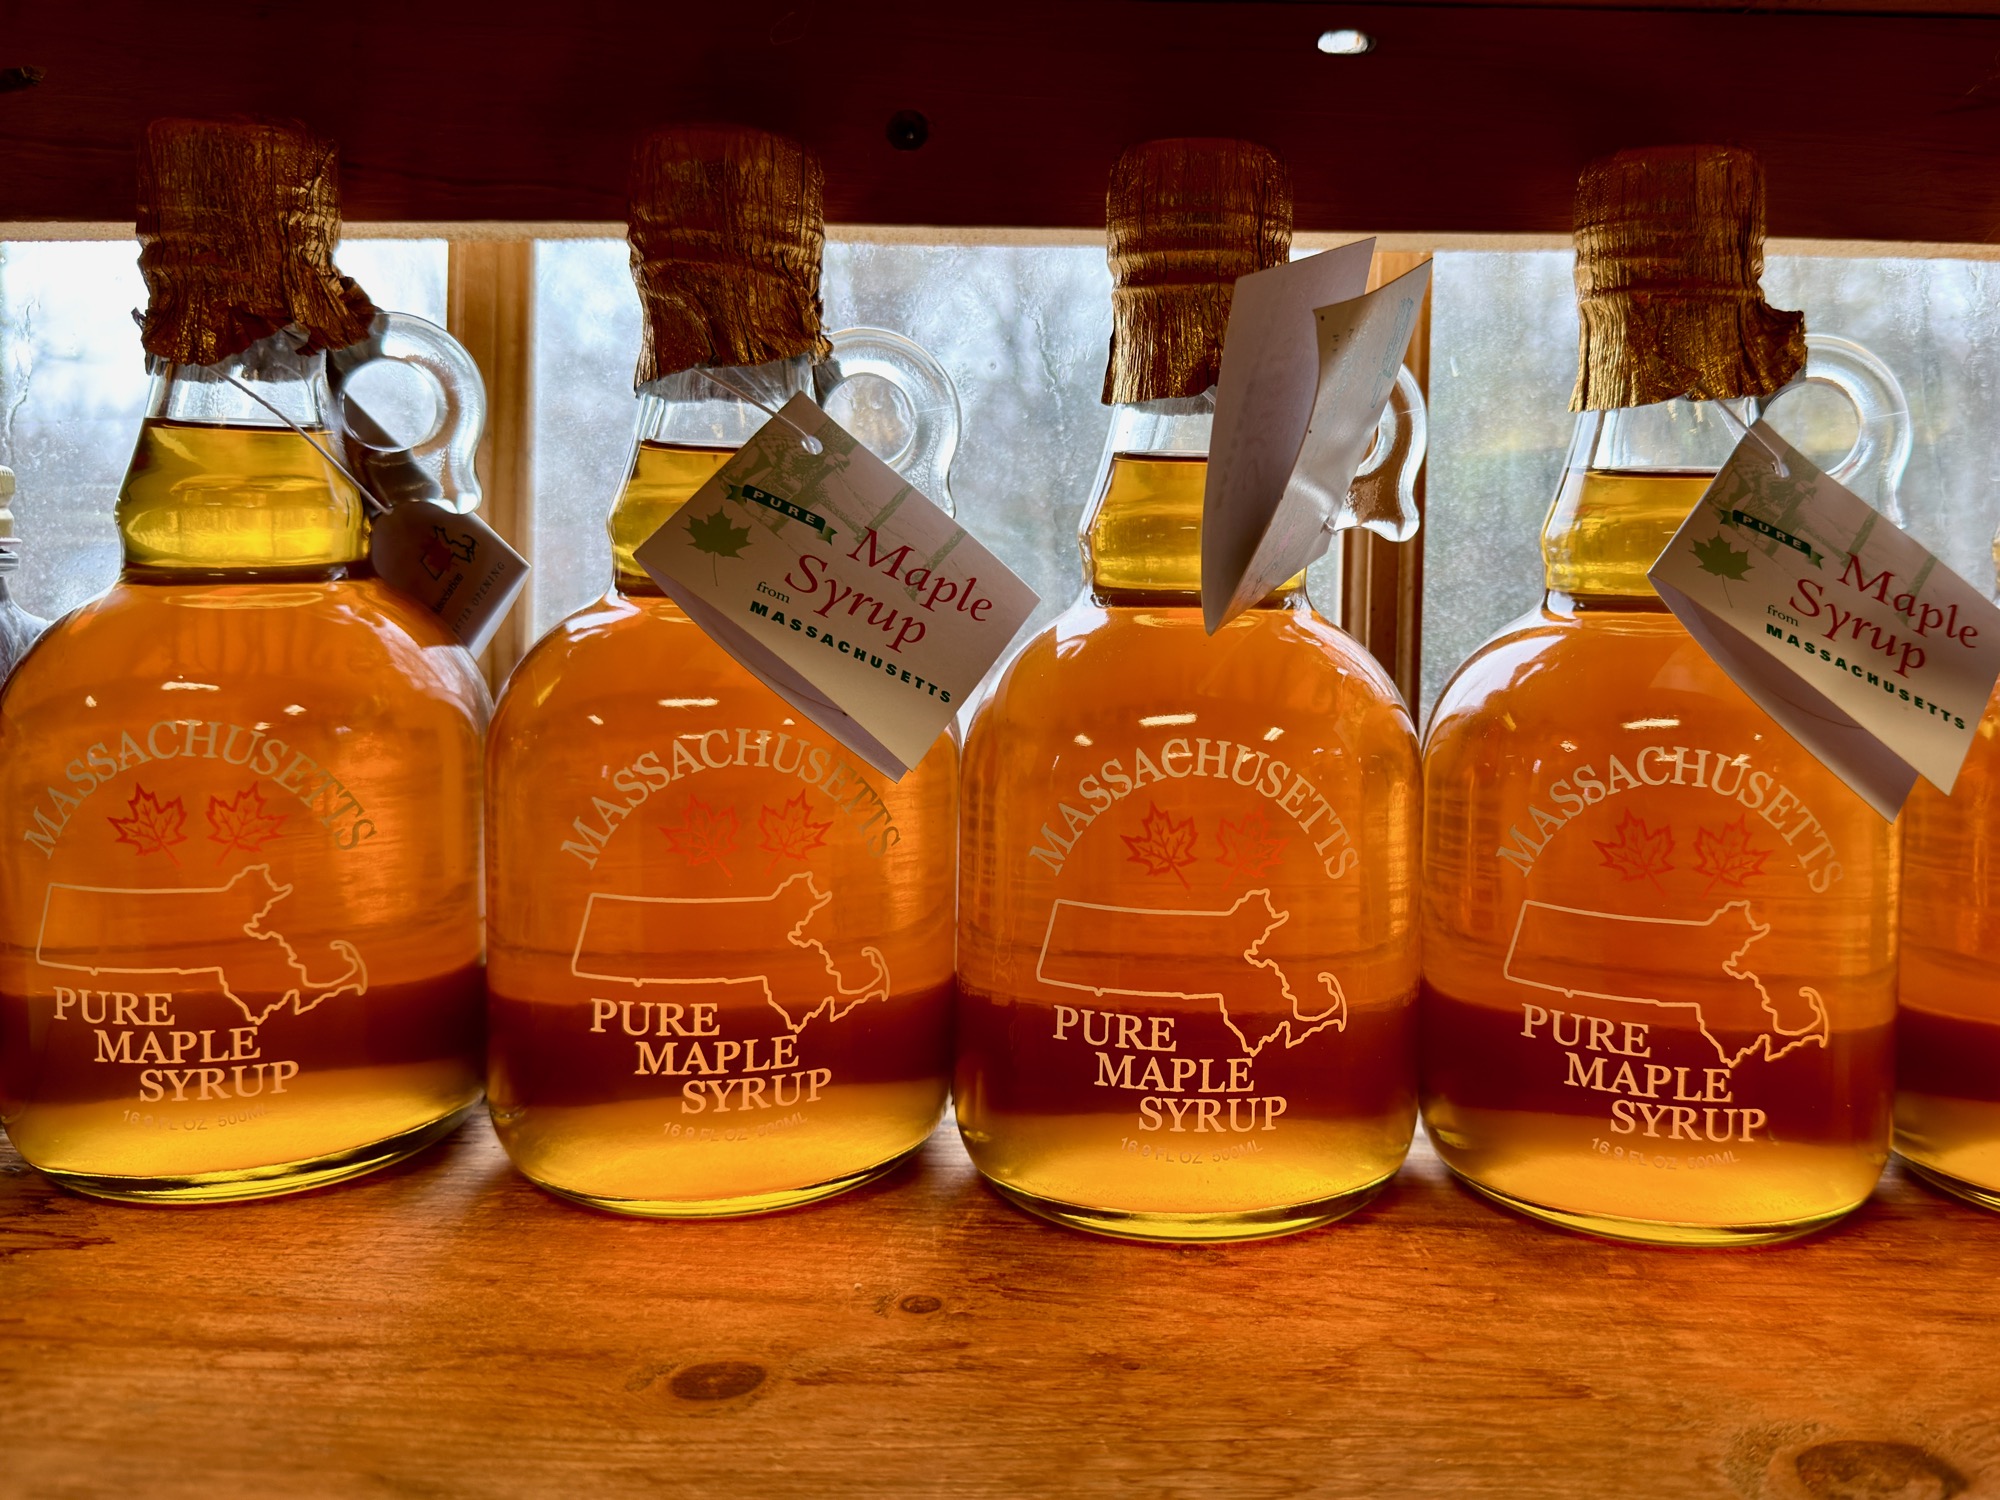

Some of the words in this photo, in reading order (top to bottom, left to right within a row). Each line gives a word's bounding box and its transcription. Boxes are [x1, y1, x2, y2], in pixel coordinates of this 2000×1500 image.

[752, 490, 816, 525] PURE
[1742, 515, 1803, 550] PURE
[472, 561, 505, 607] OPENING
[755, 580, 791, 604] from
[846, 526, 993, 621] Maple
[784, 554, 926, 653] Syrup
[1766, 604, 1799, 627] from
[1836, 552, 1979, 649] Maple
[1789, 578, 1926, 678] Syrup
[749, 600, 952, 703] MASSACHUSETTS
[1766, 623, 1965, 730] MASSACHUSETTS
[24, 720, 377, 859] MASSACHUSETTS
[560, 728, 901, 870] MASSACHUSETTS
[1029, 738, 1360, 880] MASSACHUSETTS
[1496, 745, 1844, 894] MASSACHUSETTS
[53, 986, 175, 1026] PURE
[590, 999, 720, 1036] PURE
[1052, 1004, 1177, 1052] PURE
[94, 1027, 261, 1064] MAPLE
[1520, 1003, 1651, 1058] PURE
[634, 1034, 800, 1075] MAPLE
[1094, 1051, 1254, 1093] MAPLE
[1564, 1051, 1733, 1103] MAPLE
[140, 1060, 299, 1102] SYRUP
[681, 1067, 832, 1114] SYRUP
[724, 1129, 747, 1142] OZ
[1138, 1095, 1287, 1133] SYRUP
[1610, 1099, 1767, 1143] SYRUP
[1155, 1147, 1175, 1163] FL
[1179, 1151, 1203, 1164] OZ
[1591, 1136, 1624, 1158] 16.9
[1627, 1149, 1648, 1166] FL
[1653, 1155, 1677, 1170] OZ
[1687, 1149, 1740, 1170] 500ML
